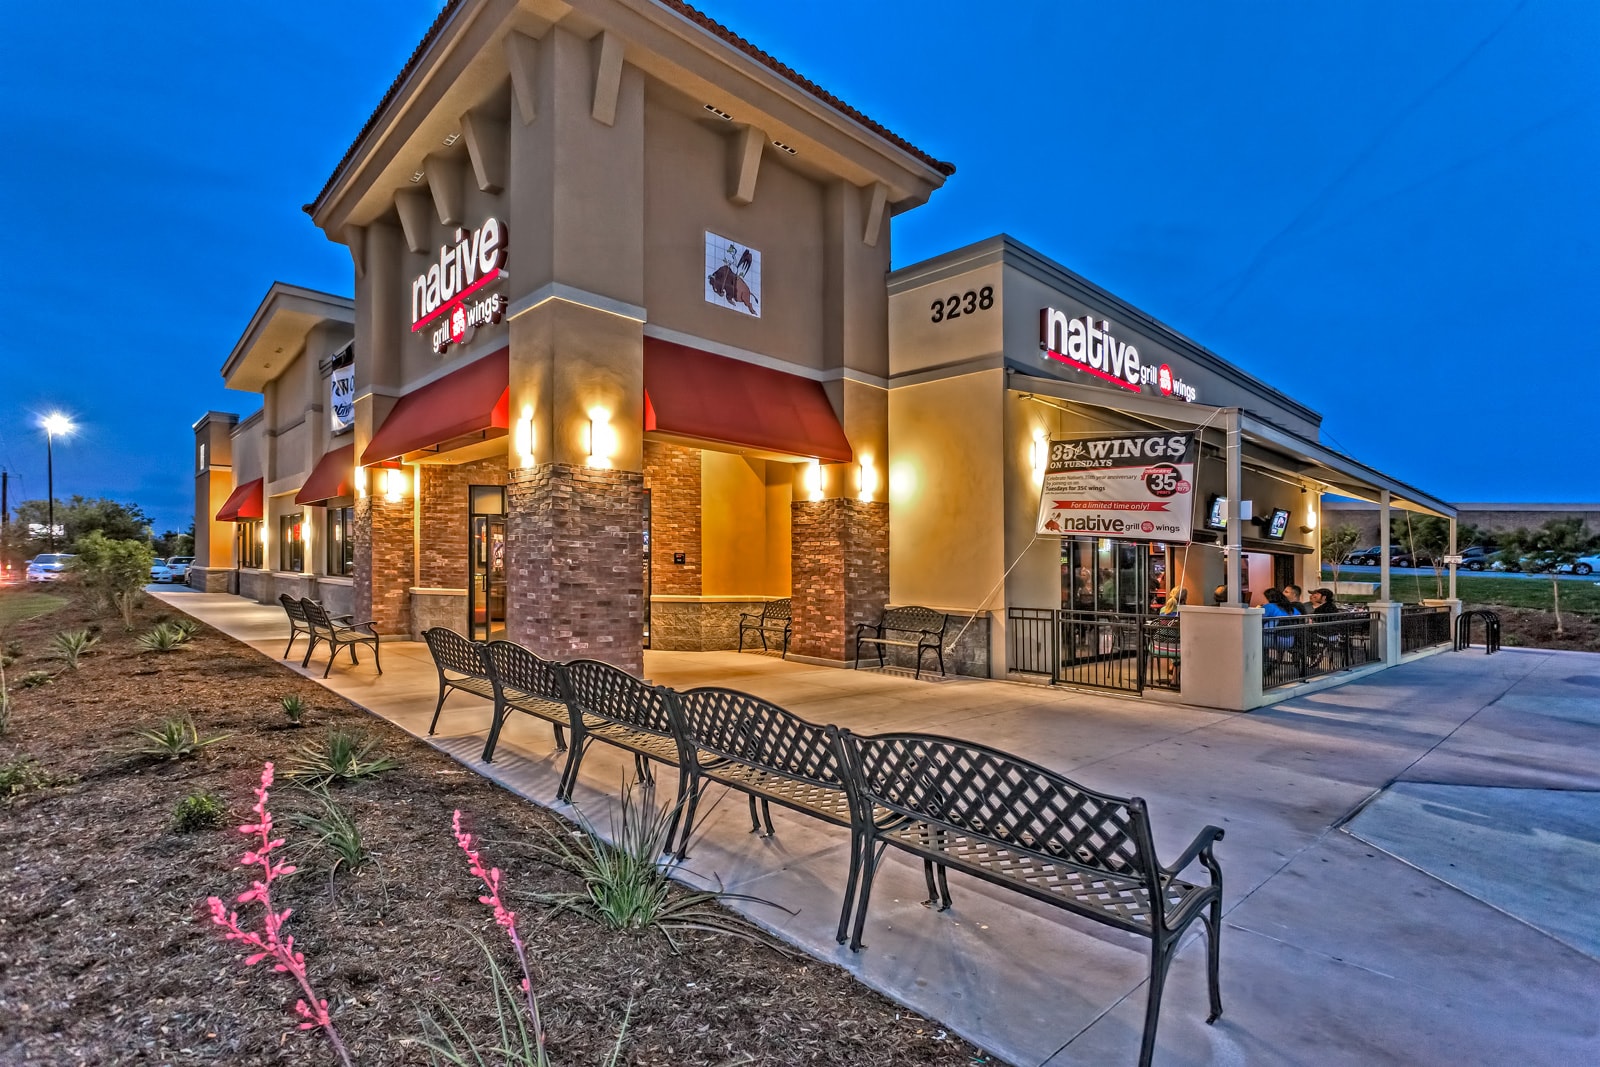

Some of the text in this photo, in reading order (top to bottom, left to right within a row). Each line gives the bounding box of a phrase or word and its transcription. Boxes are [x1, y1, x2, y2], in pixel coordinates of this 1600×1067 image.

[412, 217, 499, 323] native
[930, 286, 994, 323] 3238
[433, 318, 450, 353] grill
[467, 293, 499, 323] wings
[1047, 306, 1140, 385] native
[1140, 365, 1158, 385] grill
[1172, 378, 1196, 403] wings
[1087, 436, 1187, 459] WINGS
[1063, 459, 1113, 469] TUESDAYS
[1150, 472, 1177, 491] 35
[1130, 503, 1150, 511] only!
[1064, 515, 1124, 532] native
[1125, 523, 1140, 531] grill
[1155, 523, 1180, 533] wings
